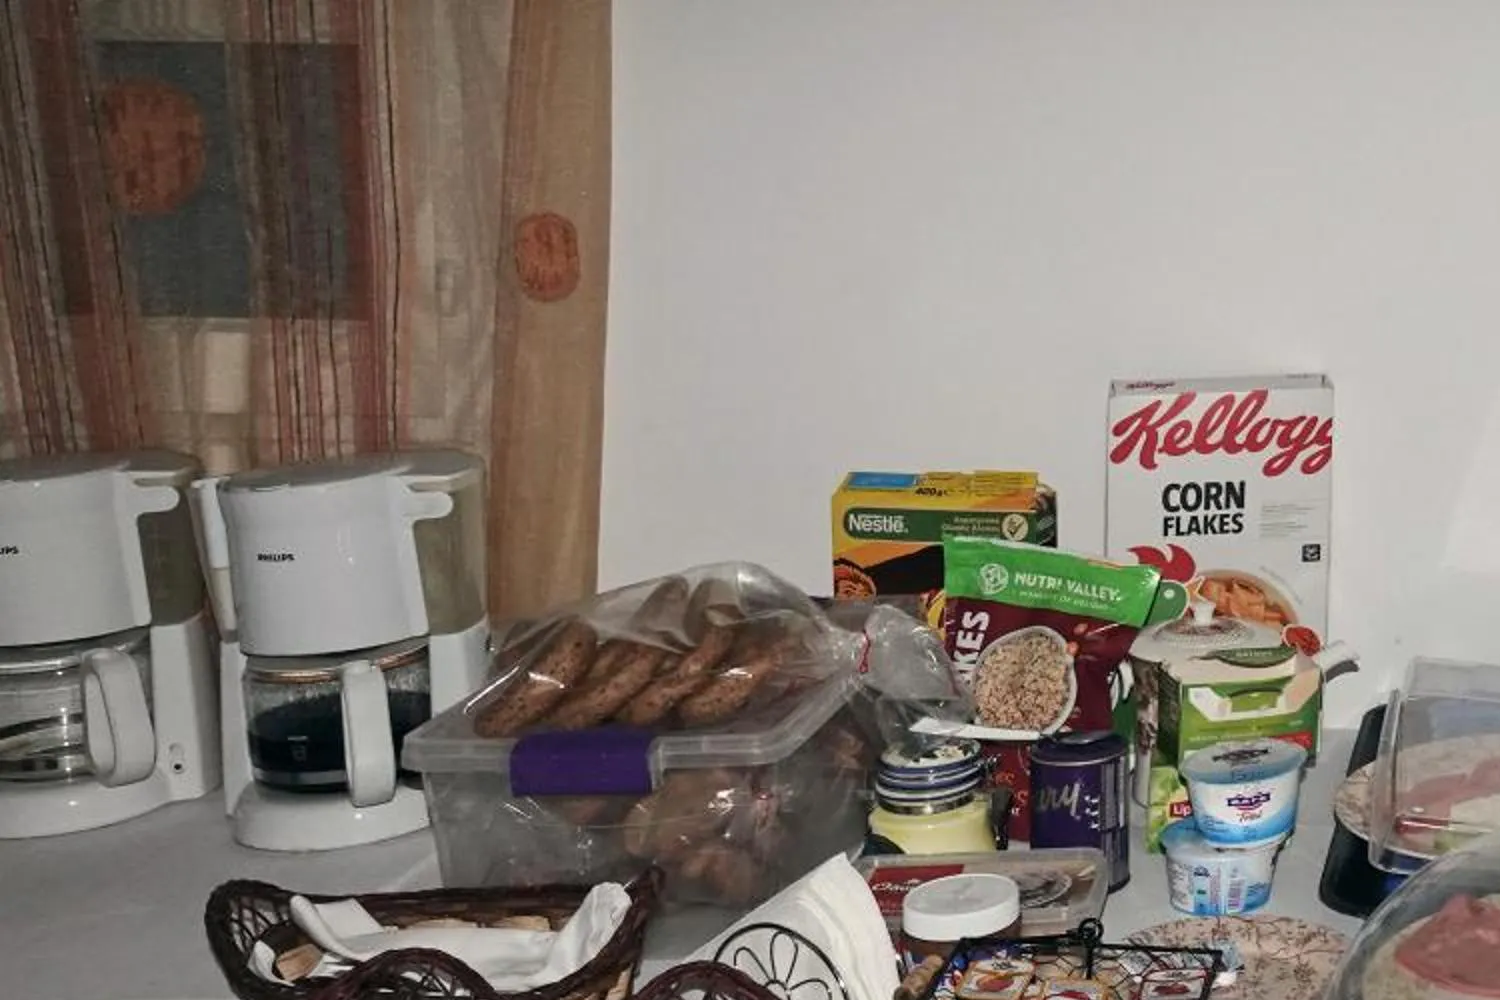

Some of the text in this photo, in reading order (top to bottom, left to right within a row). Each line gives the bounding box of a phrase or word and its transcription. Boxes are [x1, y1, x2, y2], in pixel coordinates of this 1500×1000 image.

[1162, 481, 1246, 513] CORN
[1163, 513, 1244, 537] FLAKES
[257, 553, 296, 562] PHILIPS
[1014, 573, 1064, 591] NUTRI
[1065, 579, 1119, 601] VALLEY
